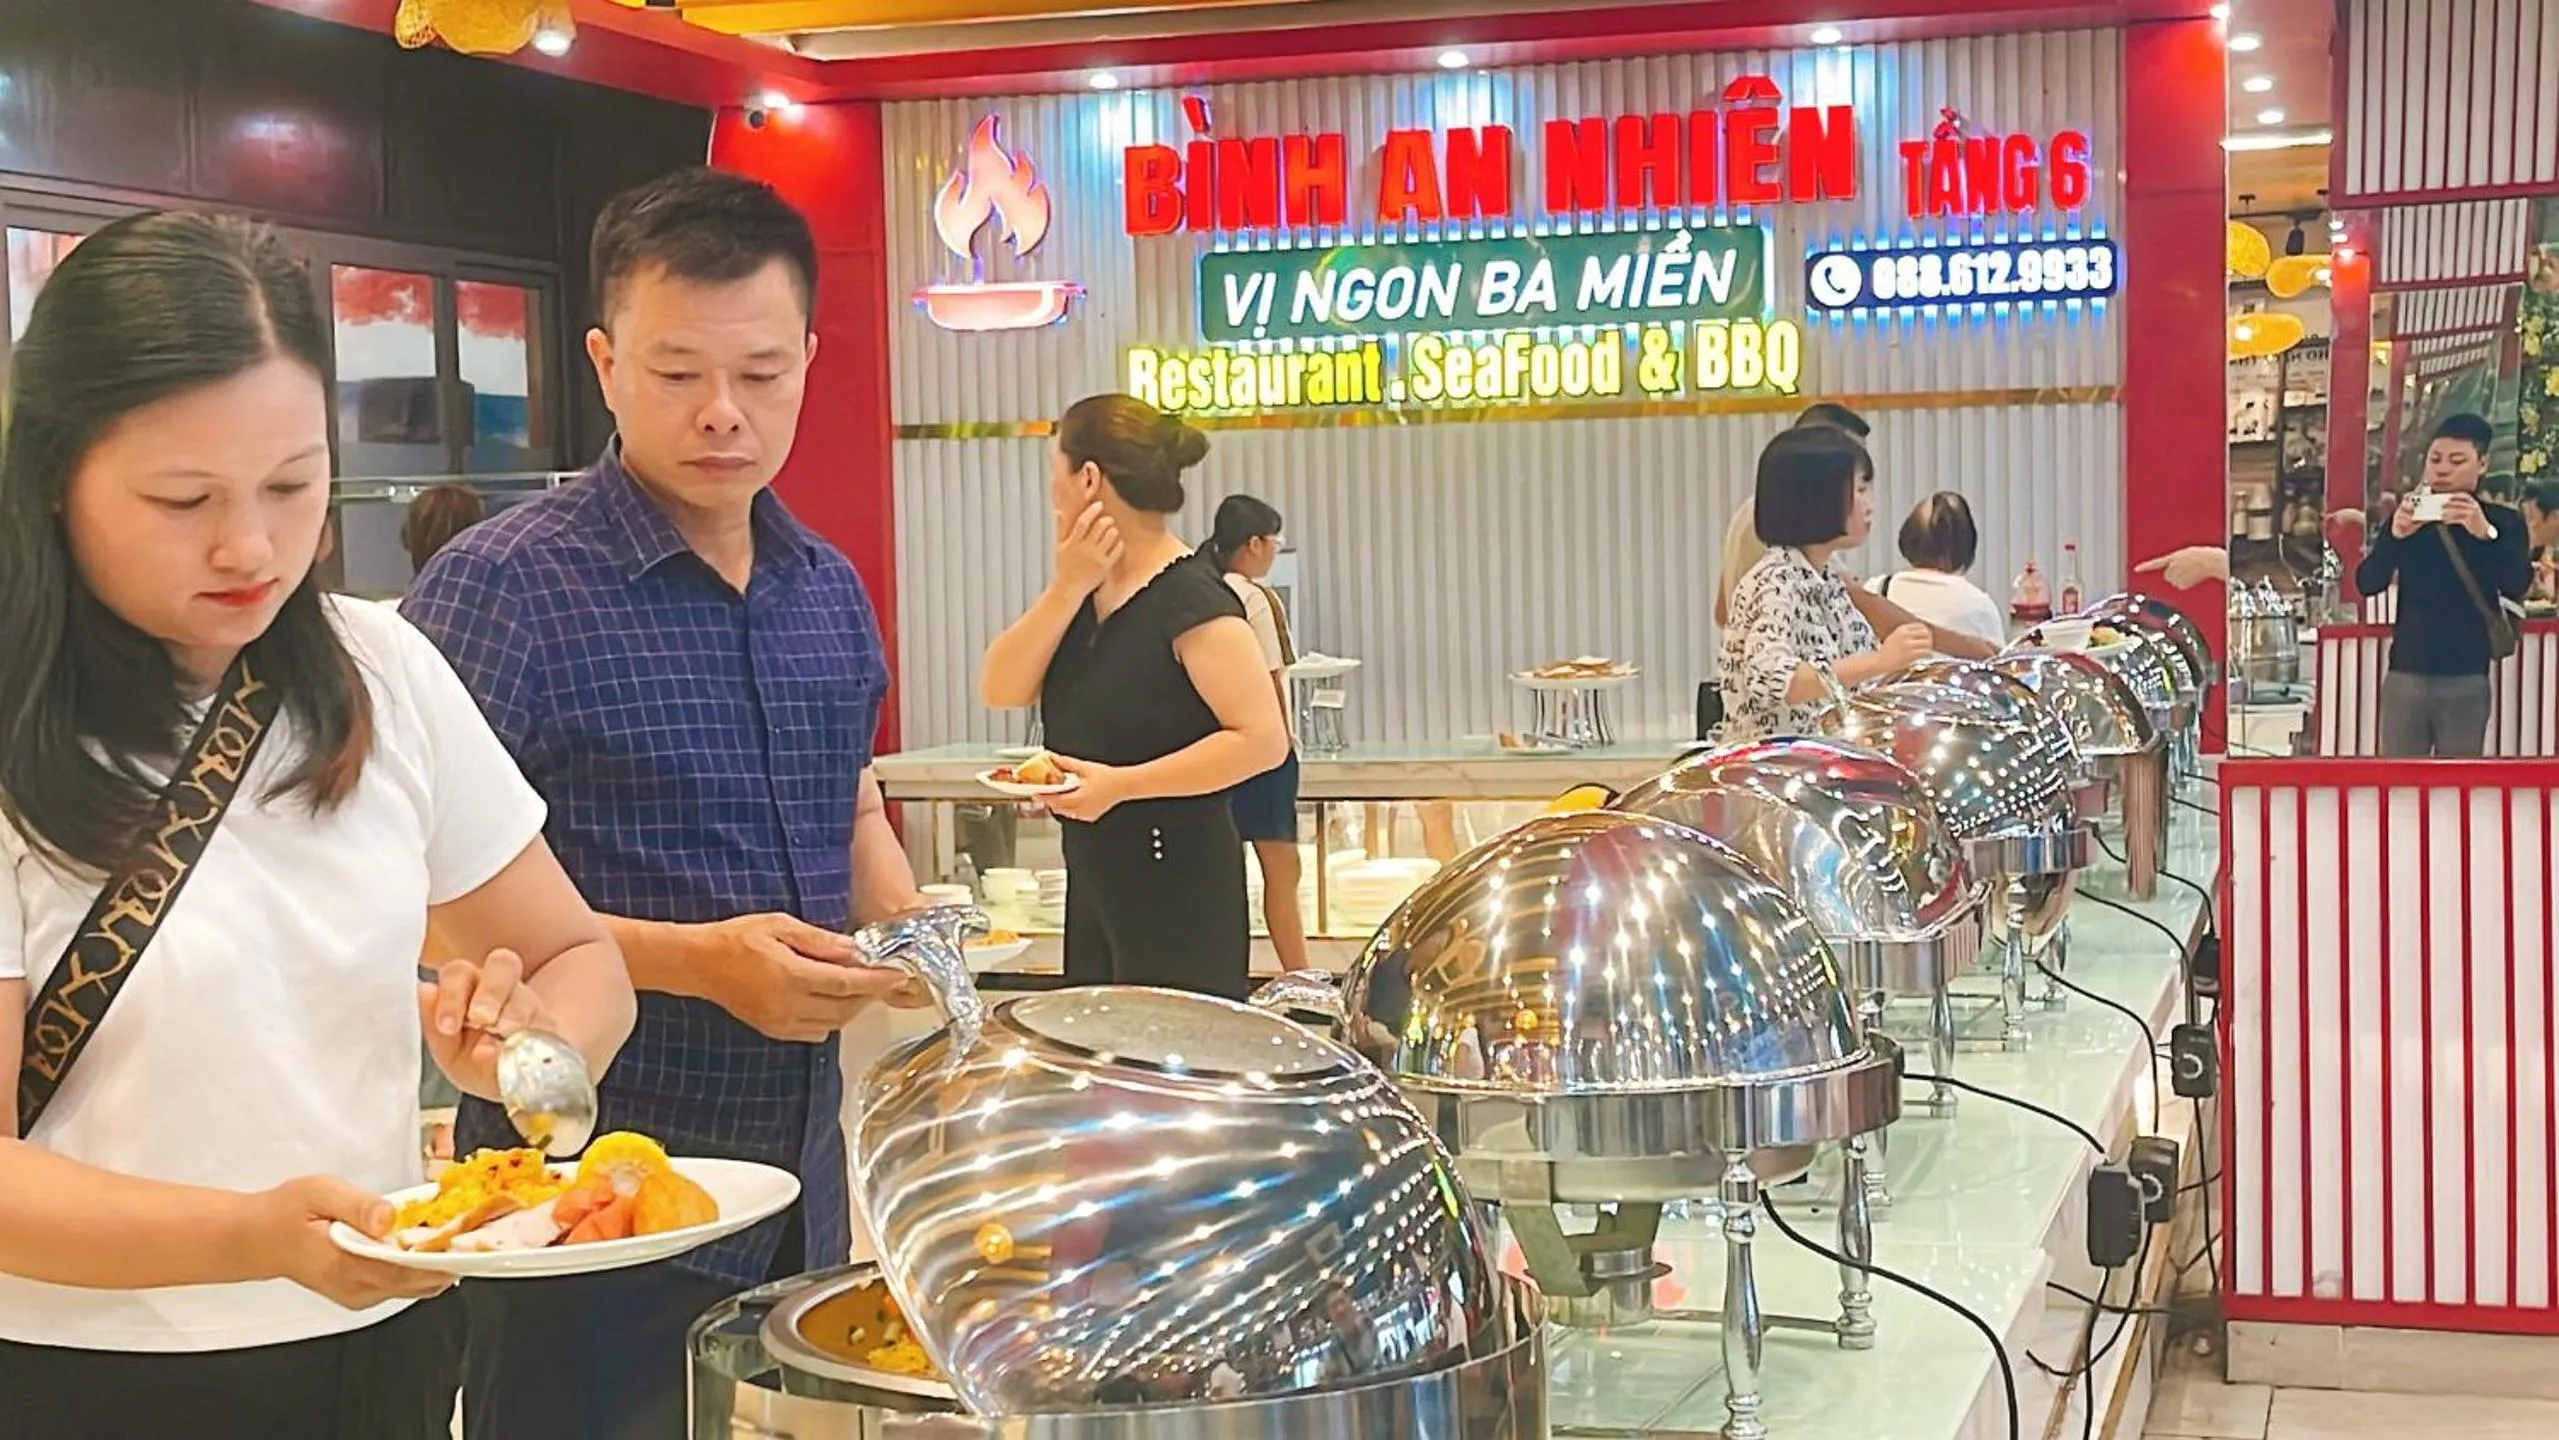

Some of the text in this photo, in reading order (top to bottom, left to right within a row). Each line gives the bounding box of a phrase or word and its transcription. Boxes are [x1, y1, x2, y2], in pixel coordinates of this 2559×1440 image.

[1124, 73, 1856, 236] BÌNH AN NHIÊN
[1899, 107, 2089, 218] TẦNG 6
[1224, 228, 1738, 339] VỊ NGON BA MIỀN
[1128, 340, 1383, 411] Restaurant
[1638, 325, 1681, 394] &
[1695, 318, 1801, 395] BBQ
